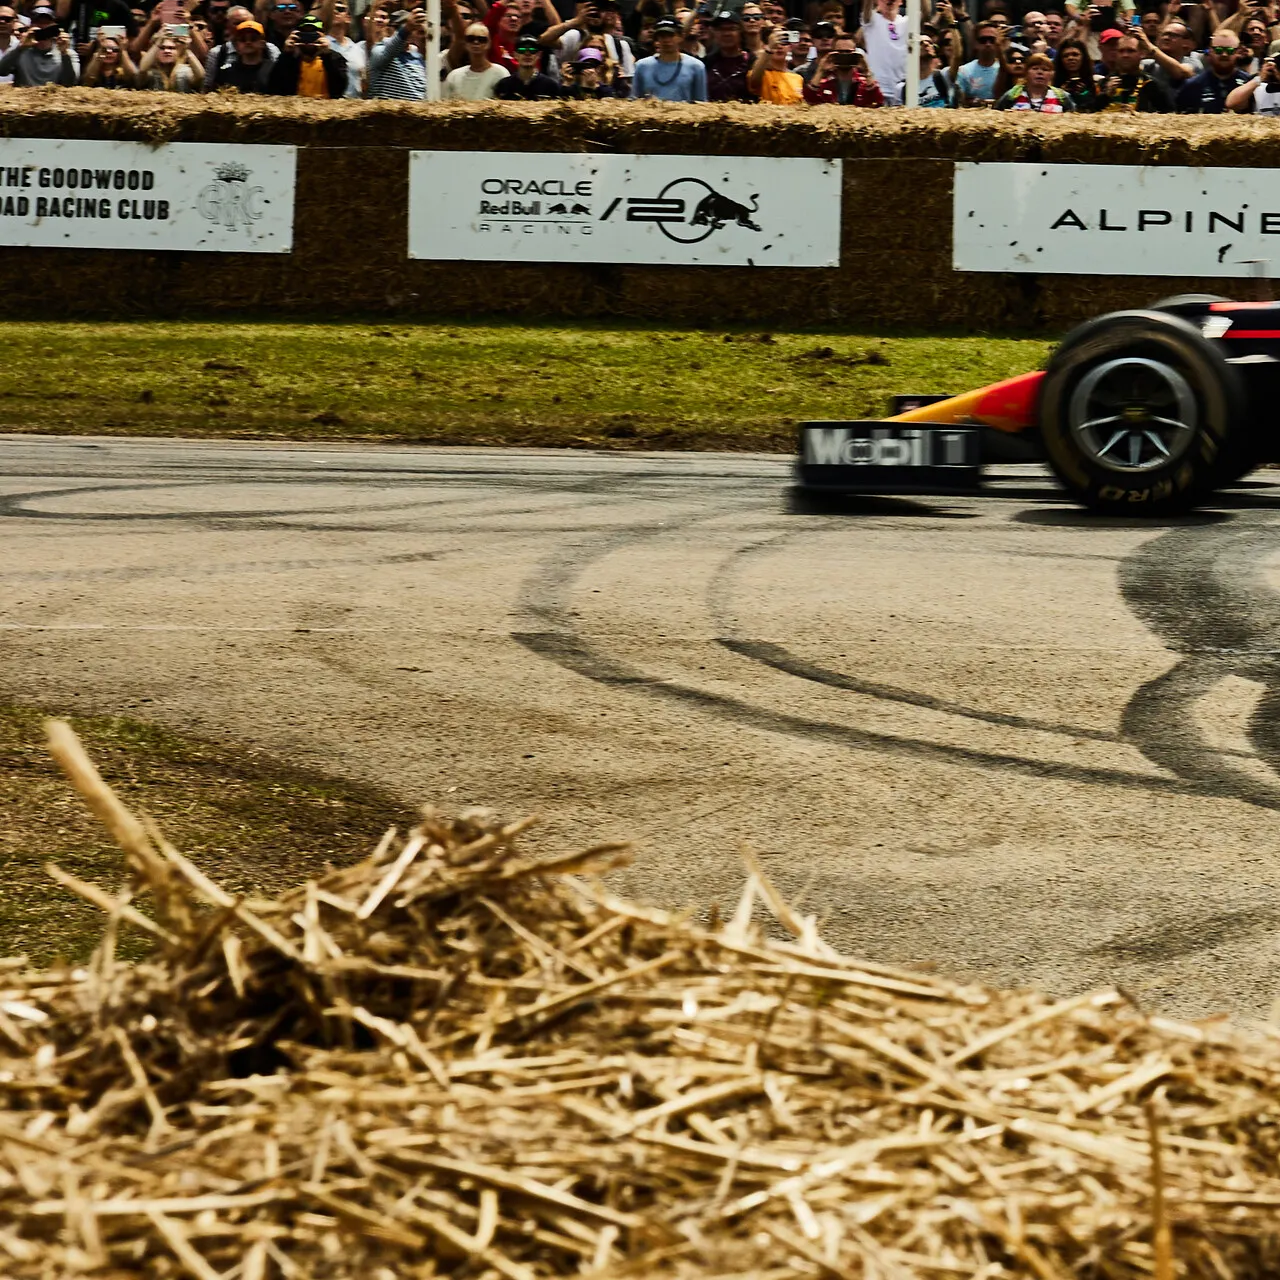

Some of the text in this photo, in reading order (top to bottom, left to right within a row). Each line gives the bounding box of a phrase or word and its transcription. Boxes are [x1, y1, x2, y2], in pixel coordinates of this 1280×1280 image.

[38, 168, 154, 191] GOODWOOD
[481, 178, 593, 196] ORACLE
[36, 197, 111, 219] RACING
[117, 199, 170, 220] CLUB
[480, 200, 541, 216] Red Bull
[479, 223, 593, 236] RACING
